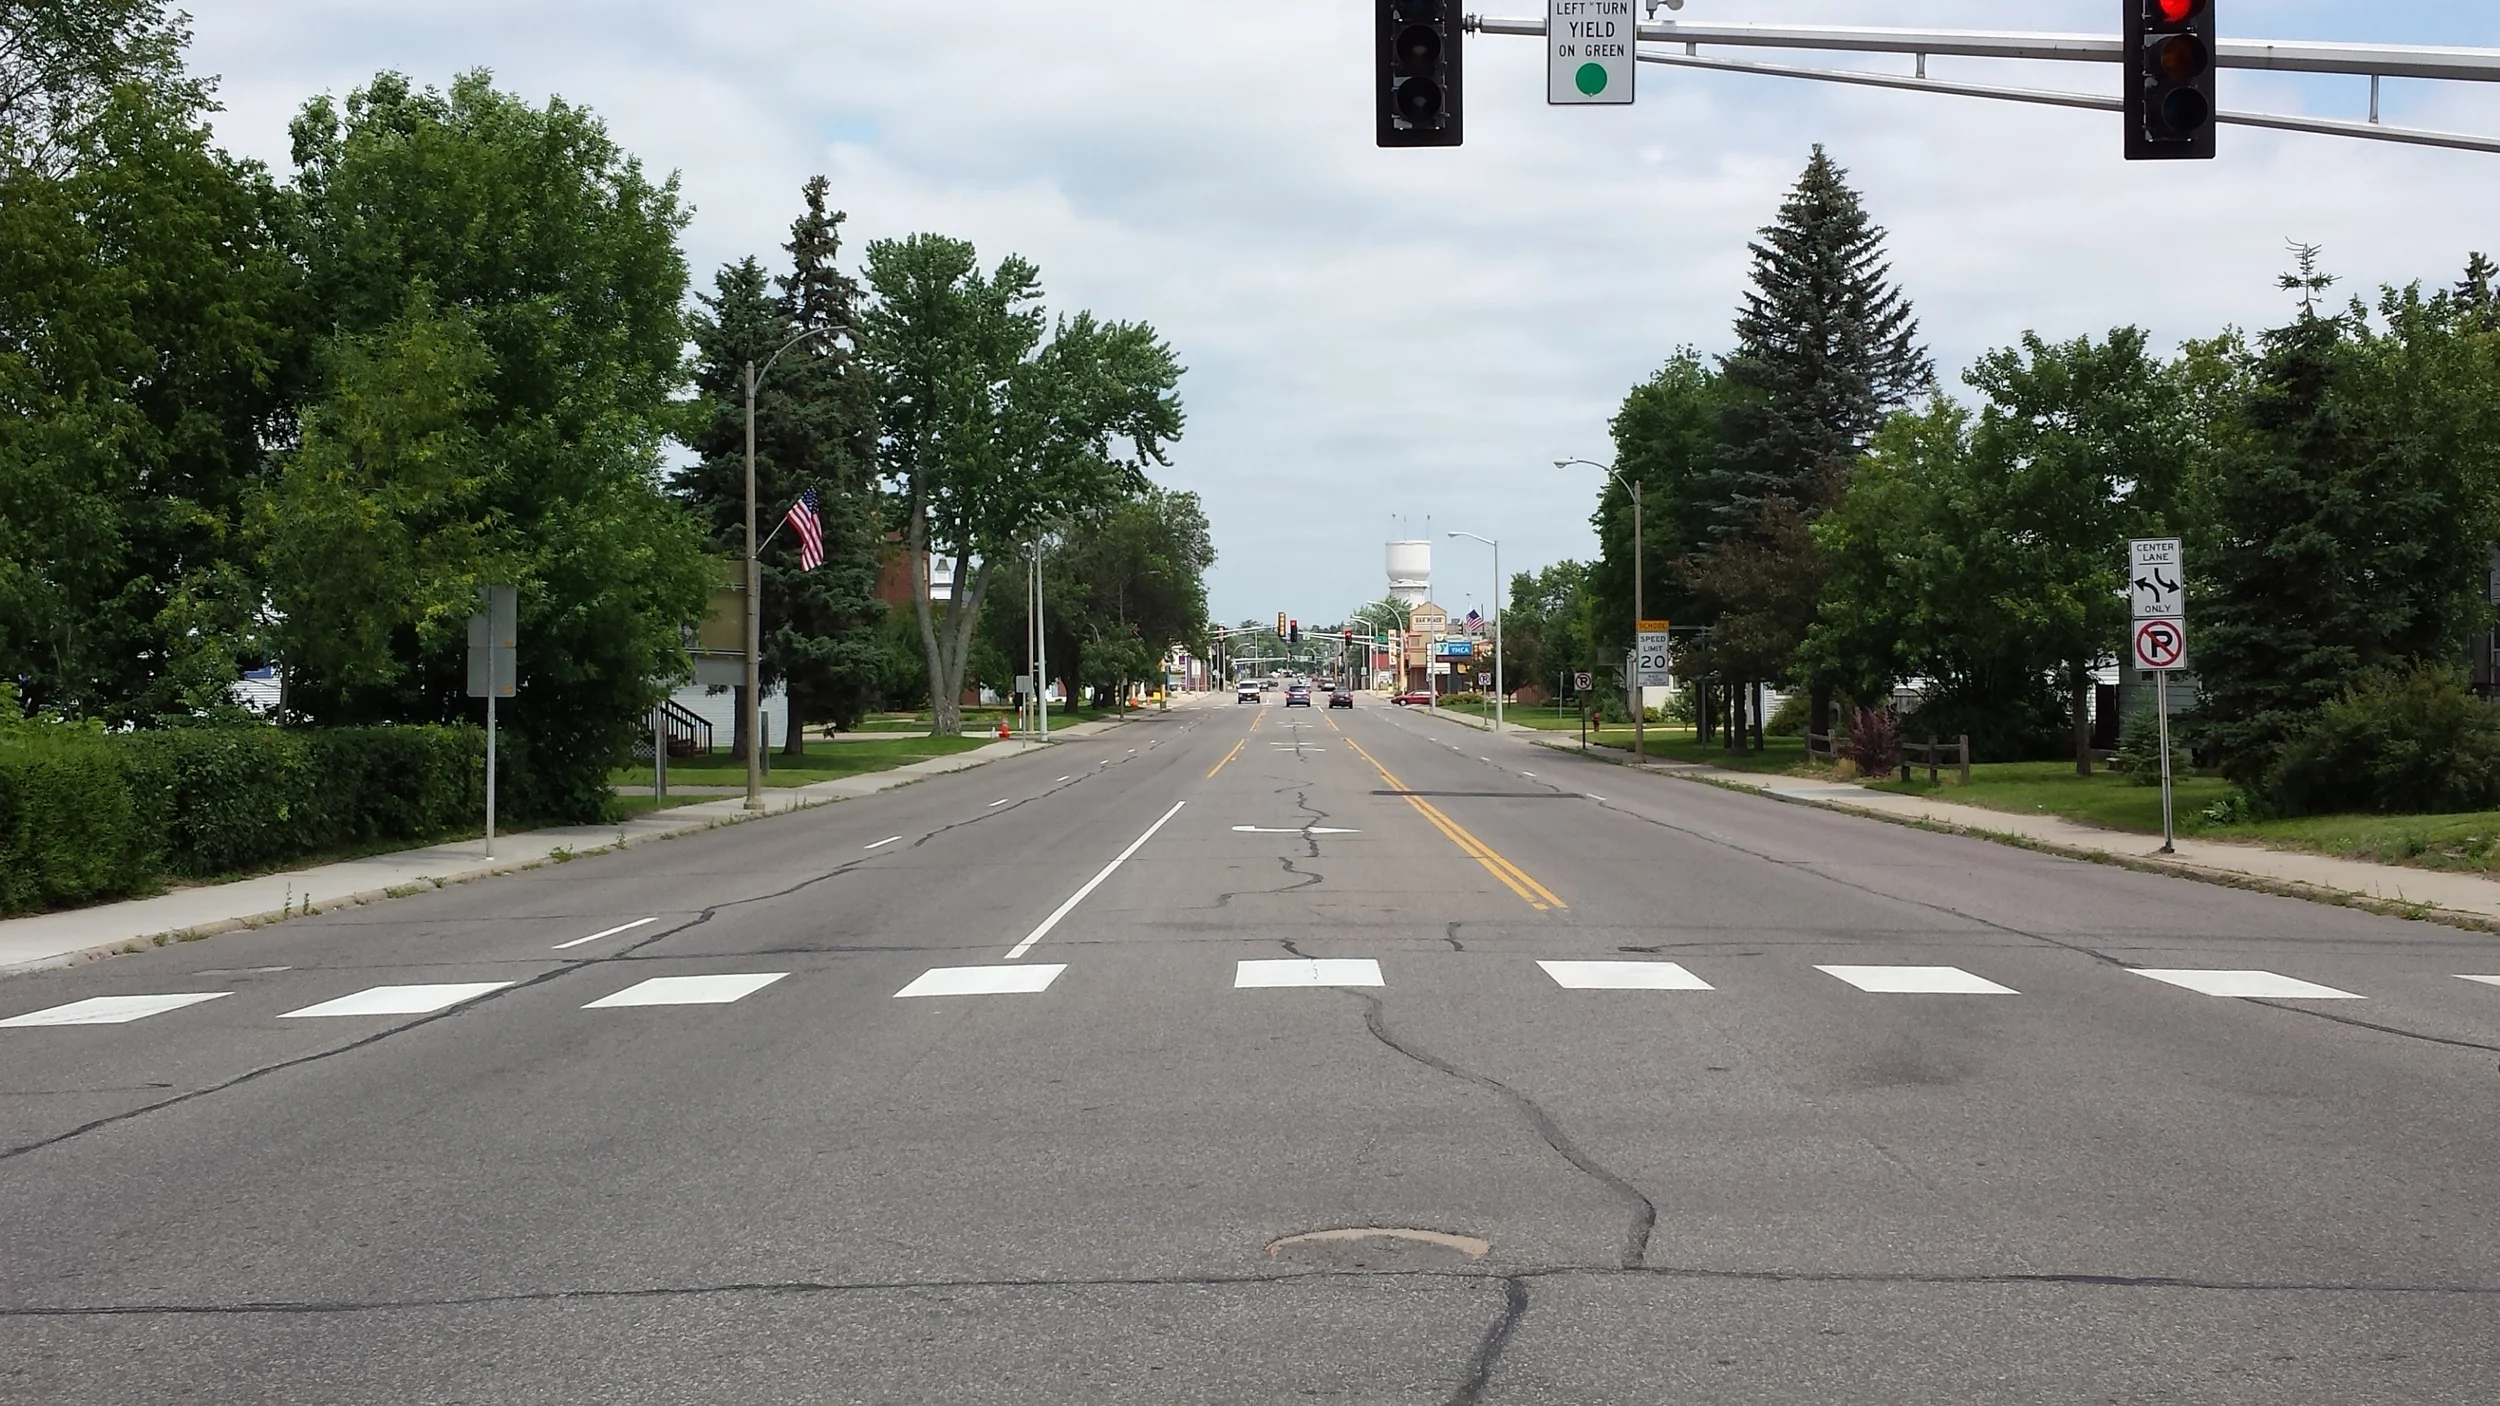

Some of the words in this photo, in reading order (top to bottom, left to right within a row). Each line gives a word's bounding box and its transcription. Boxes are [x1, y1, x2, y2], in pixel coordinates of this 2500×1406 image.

[1556, 2, 1586, 15] LEFT
[1595, 2, 1628, 15] TURN
[1569, 21, 1615, 38] YIELD
[1559, 44, 1575, 57] ON
[1585, 44, 1625, 57] GREEN
[2136, 543, 2174, 552] CENTER
[2143, 553, 2169, 561] LANE
[2145, 605, 2171, 613] ONLY
[1641, 655, 1666, 668] 20
